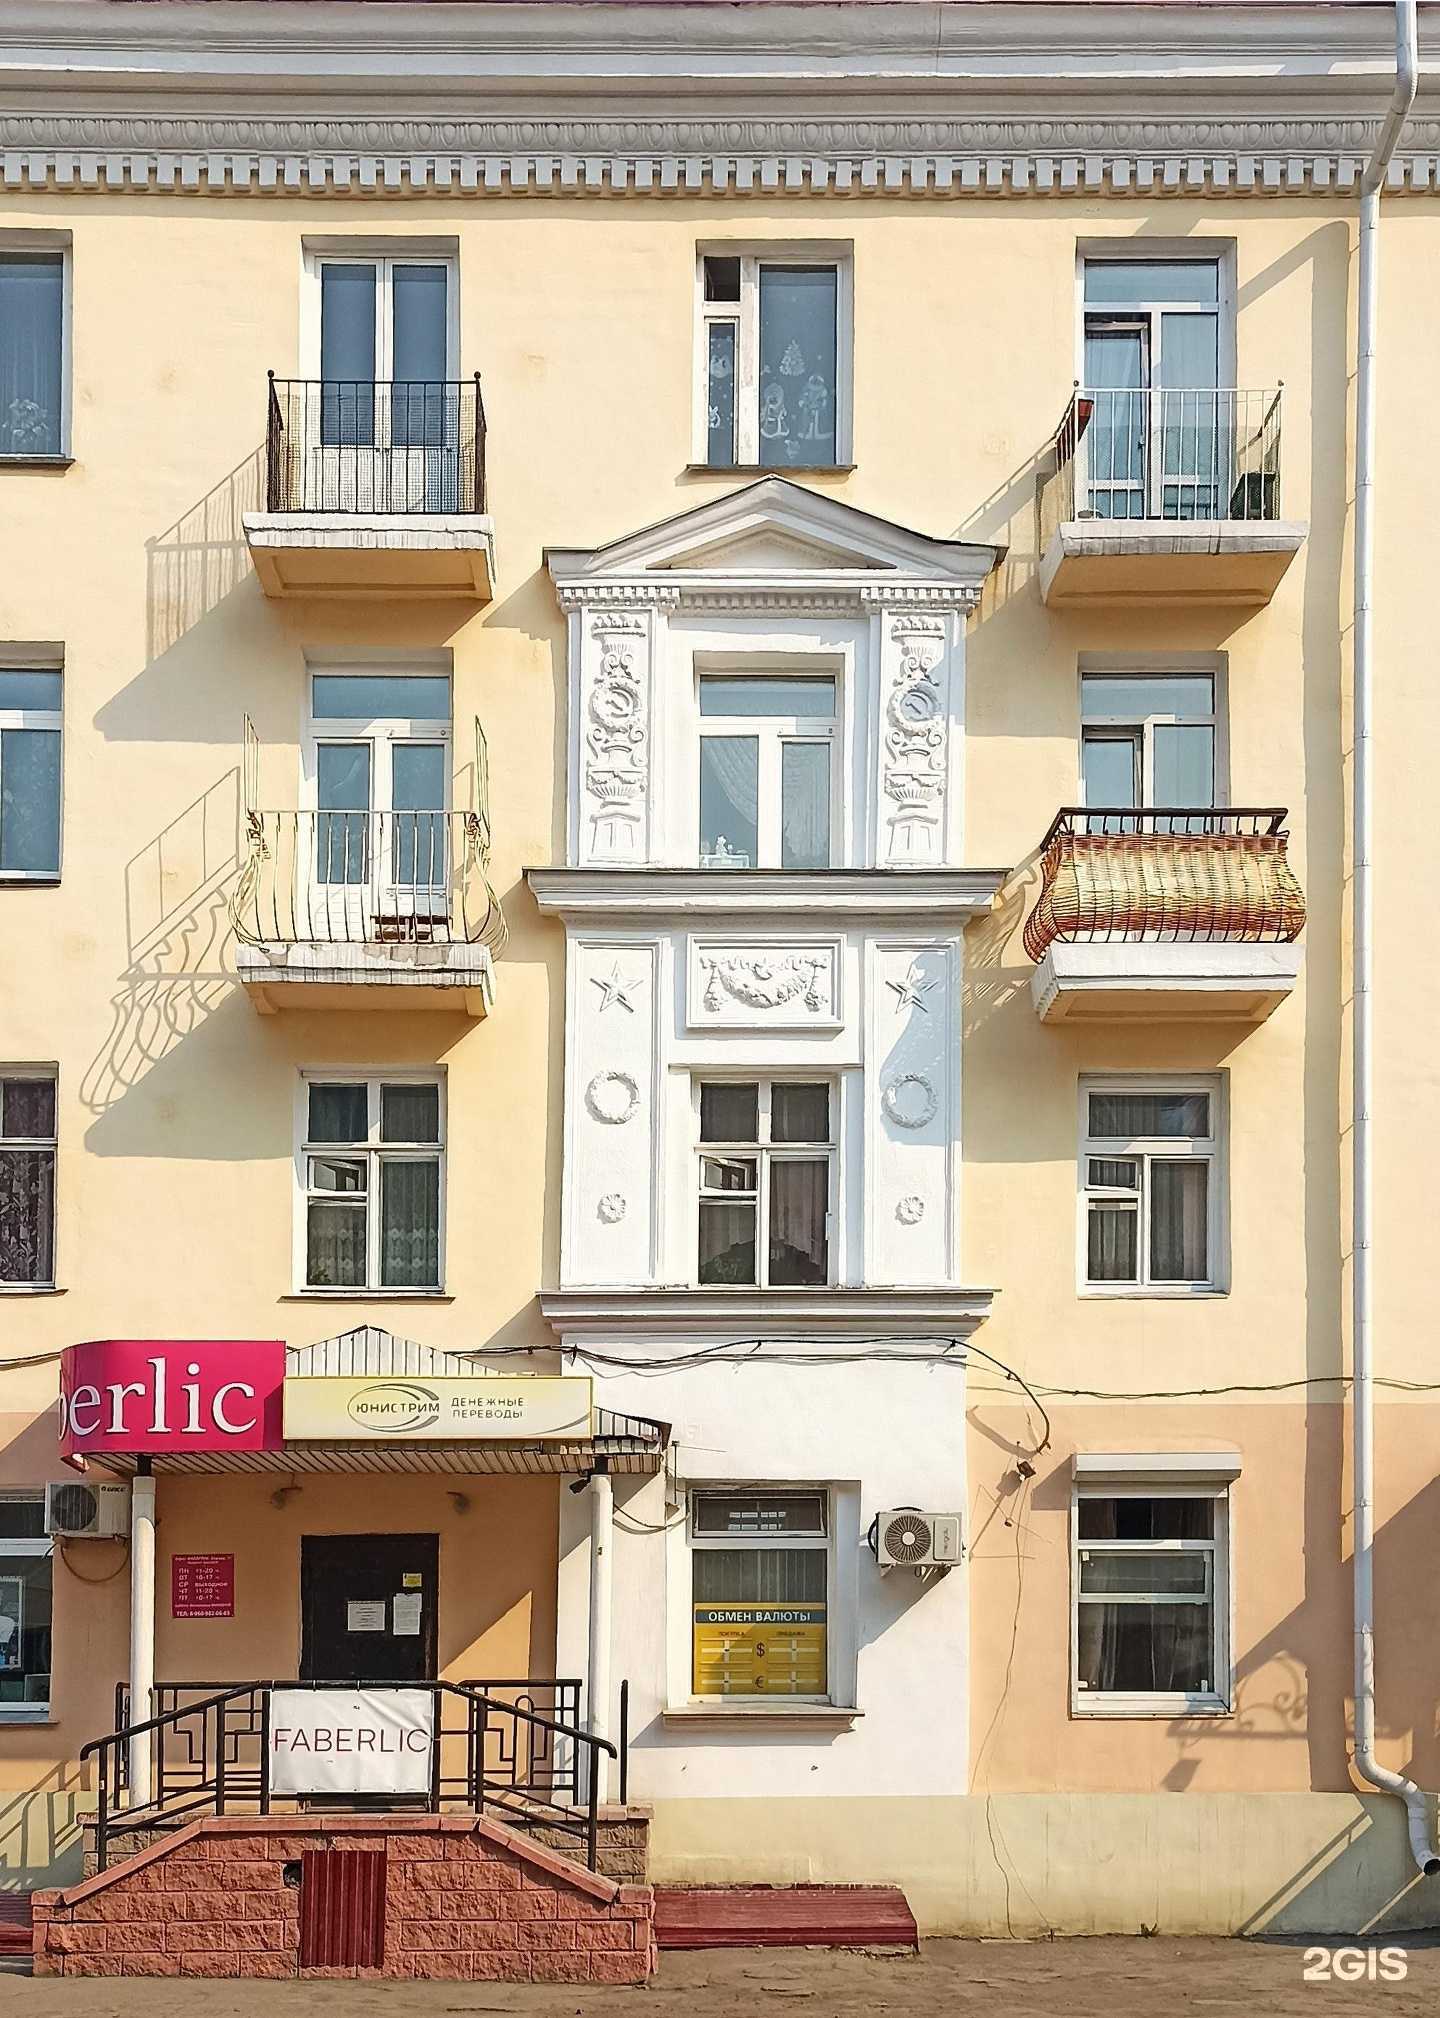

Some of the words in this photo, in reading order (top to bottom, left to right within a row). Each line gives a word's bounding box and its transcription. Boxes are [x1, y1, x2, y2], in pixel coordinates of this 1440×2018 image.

[451, 1397, 524, 1407] ДЕНЕЖНЫЕ
[356, 1403, 440, 1413] ЮНИСТРИМ
[452, 1409, 523, 1419] ПЕРЕВОДЫ
[708, 1611, 752, 1622] ОБМЕН
[755, 1611, 811, 1622] ВАЛЮТЫ
[274, 1728, 427, 1753] FABERLIC
